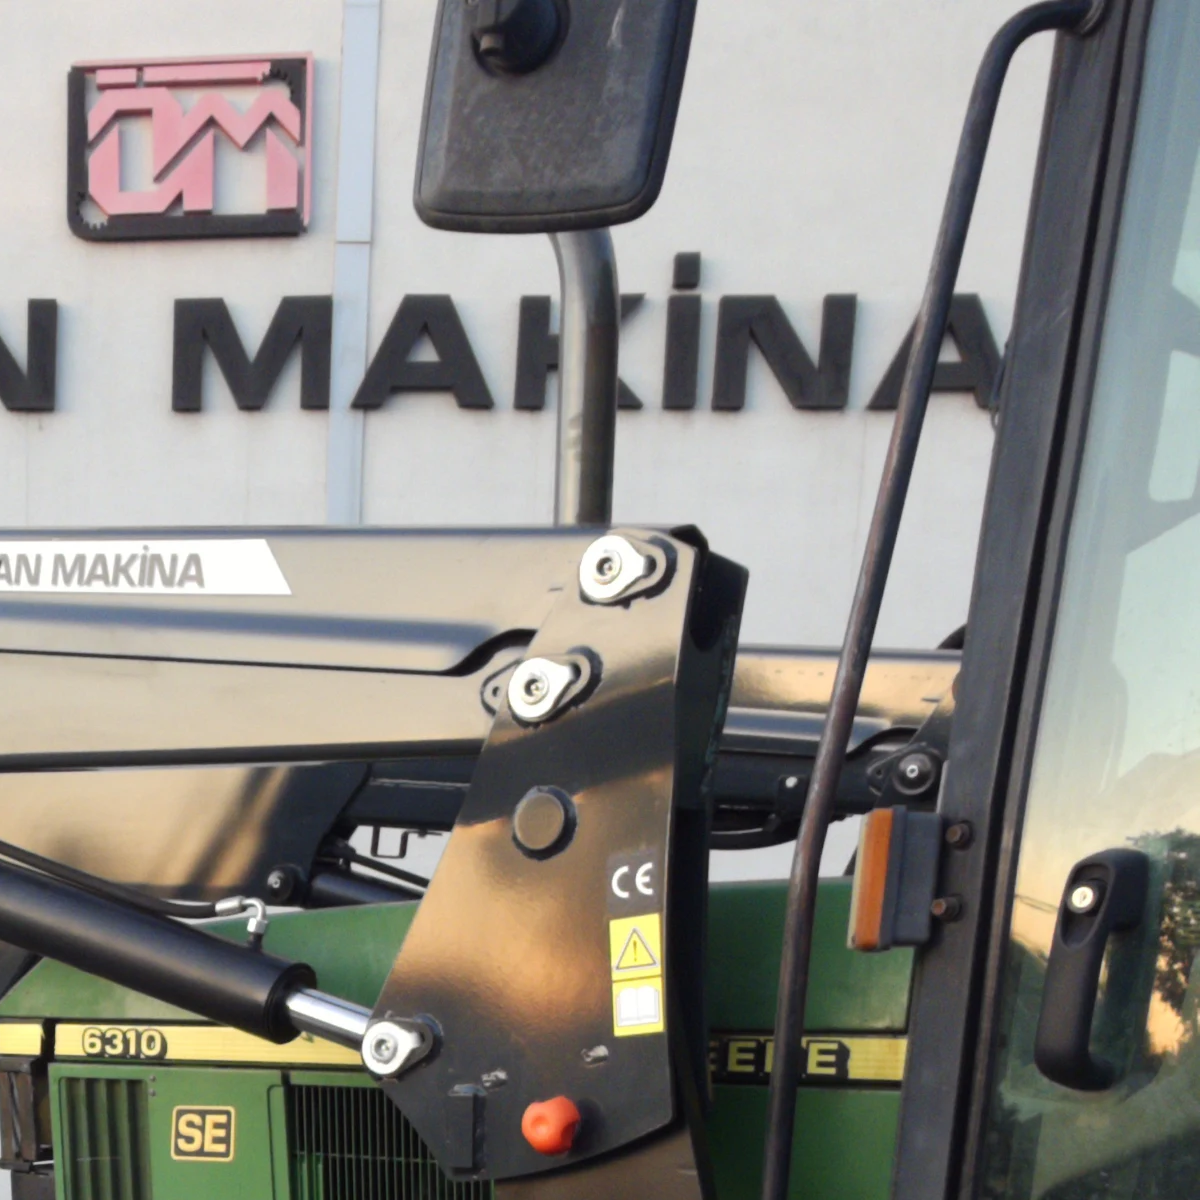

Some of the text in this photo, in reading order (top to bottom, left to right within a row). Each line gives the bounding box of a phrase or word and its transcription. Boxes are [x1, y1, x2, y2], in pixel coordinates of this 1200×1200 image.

[51, 544, 205, 588] MAKİNA
[611, 862, 653, 898] CE
[82, 1027, 166, 1059] 6310
[176, 1113, 228, 1153] SE
